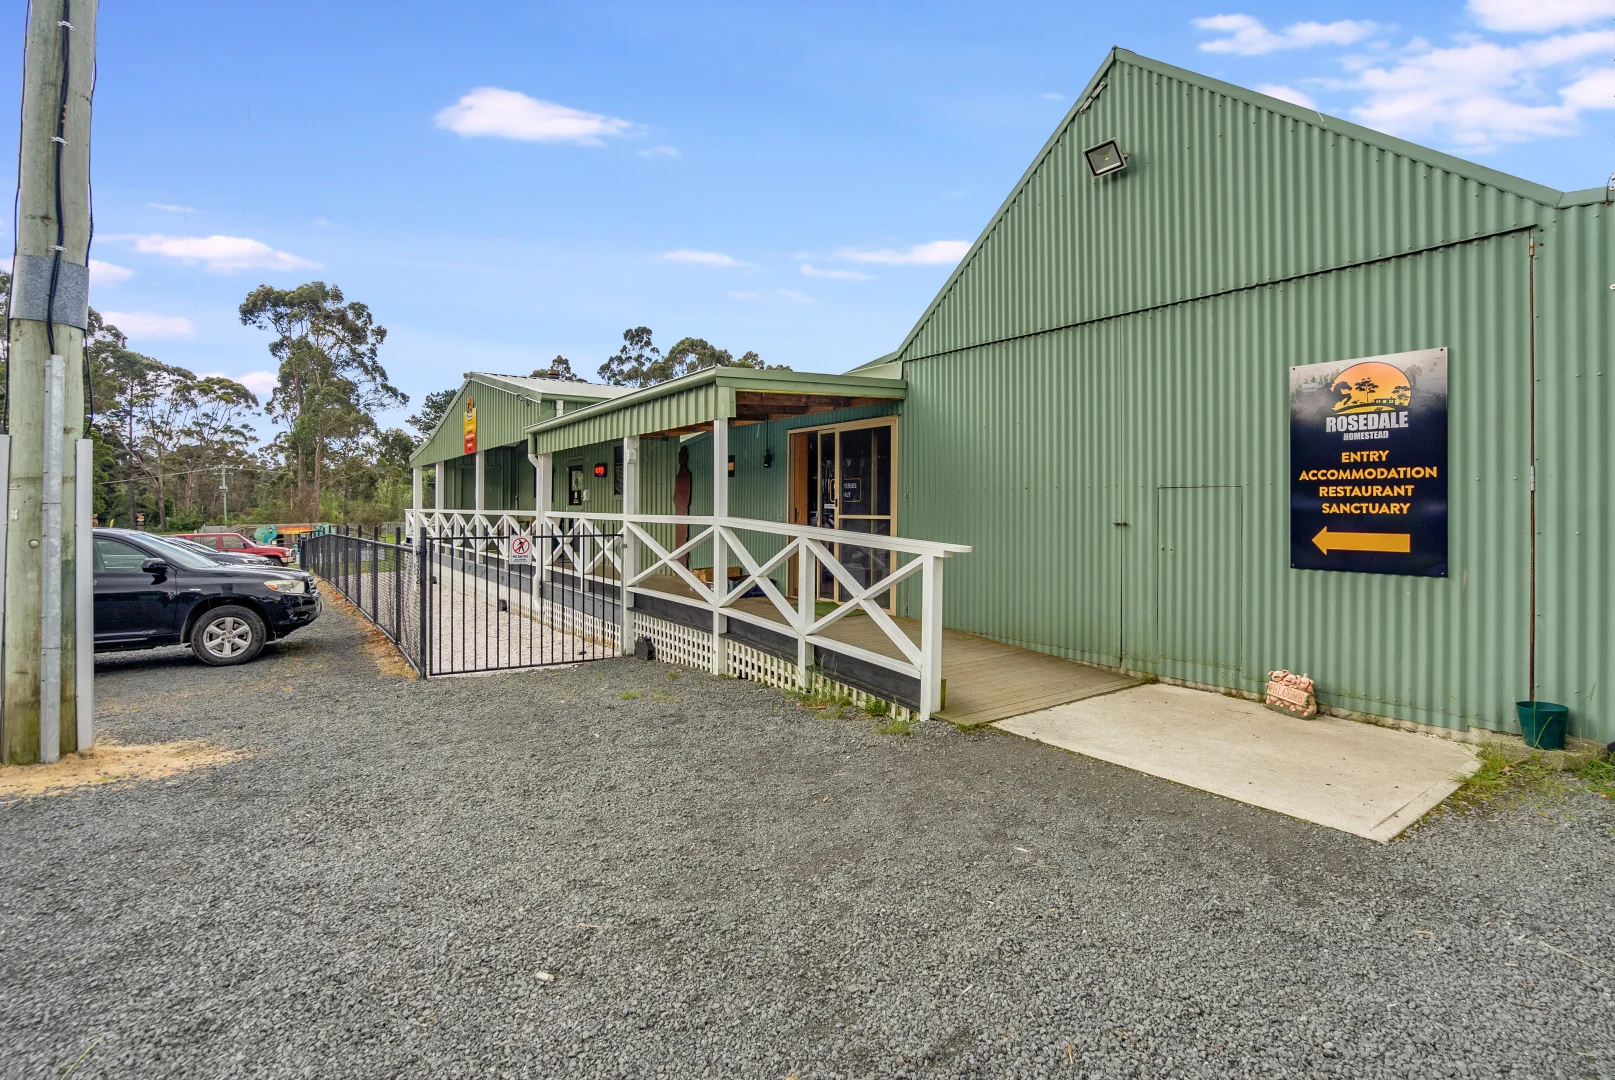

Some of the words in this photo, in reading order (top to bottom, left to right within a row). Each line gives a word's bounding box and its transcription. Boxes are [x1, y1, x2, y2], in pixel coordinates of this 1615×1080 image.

[1325, 411, 1409, 433] ROSEDALE
[1343, 430, 1389, 441] HOMESTEAD
[1341, 450, 1389, 463] ENTRY
[1299, 466, 1438, 481] ACCOMMODATION
[1319, 485, 1415, 497] RESTAURANT
[1321, 503, 1411, 514] SANCTUARY
